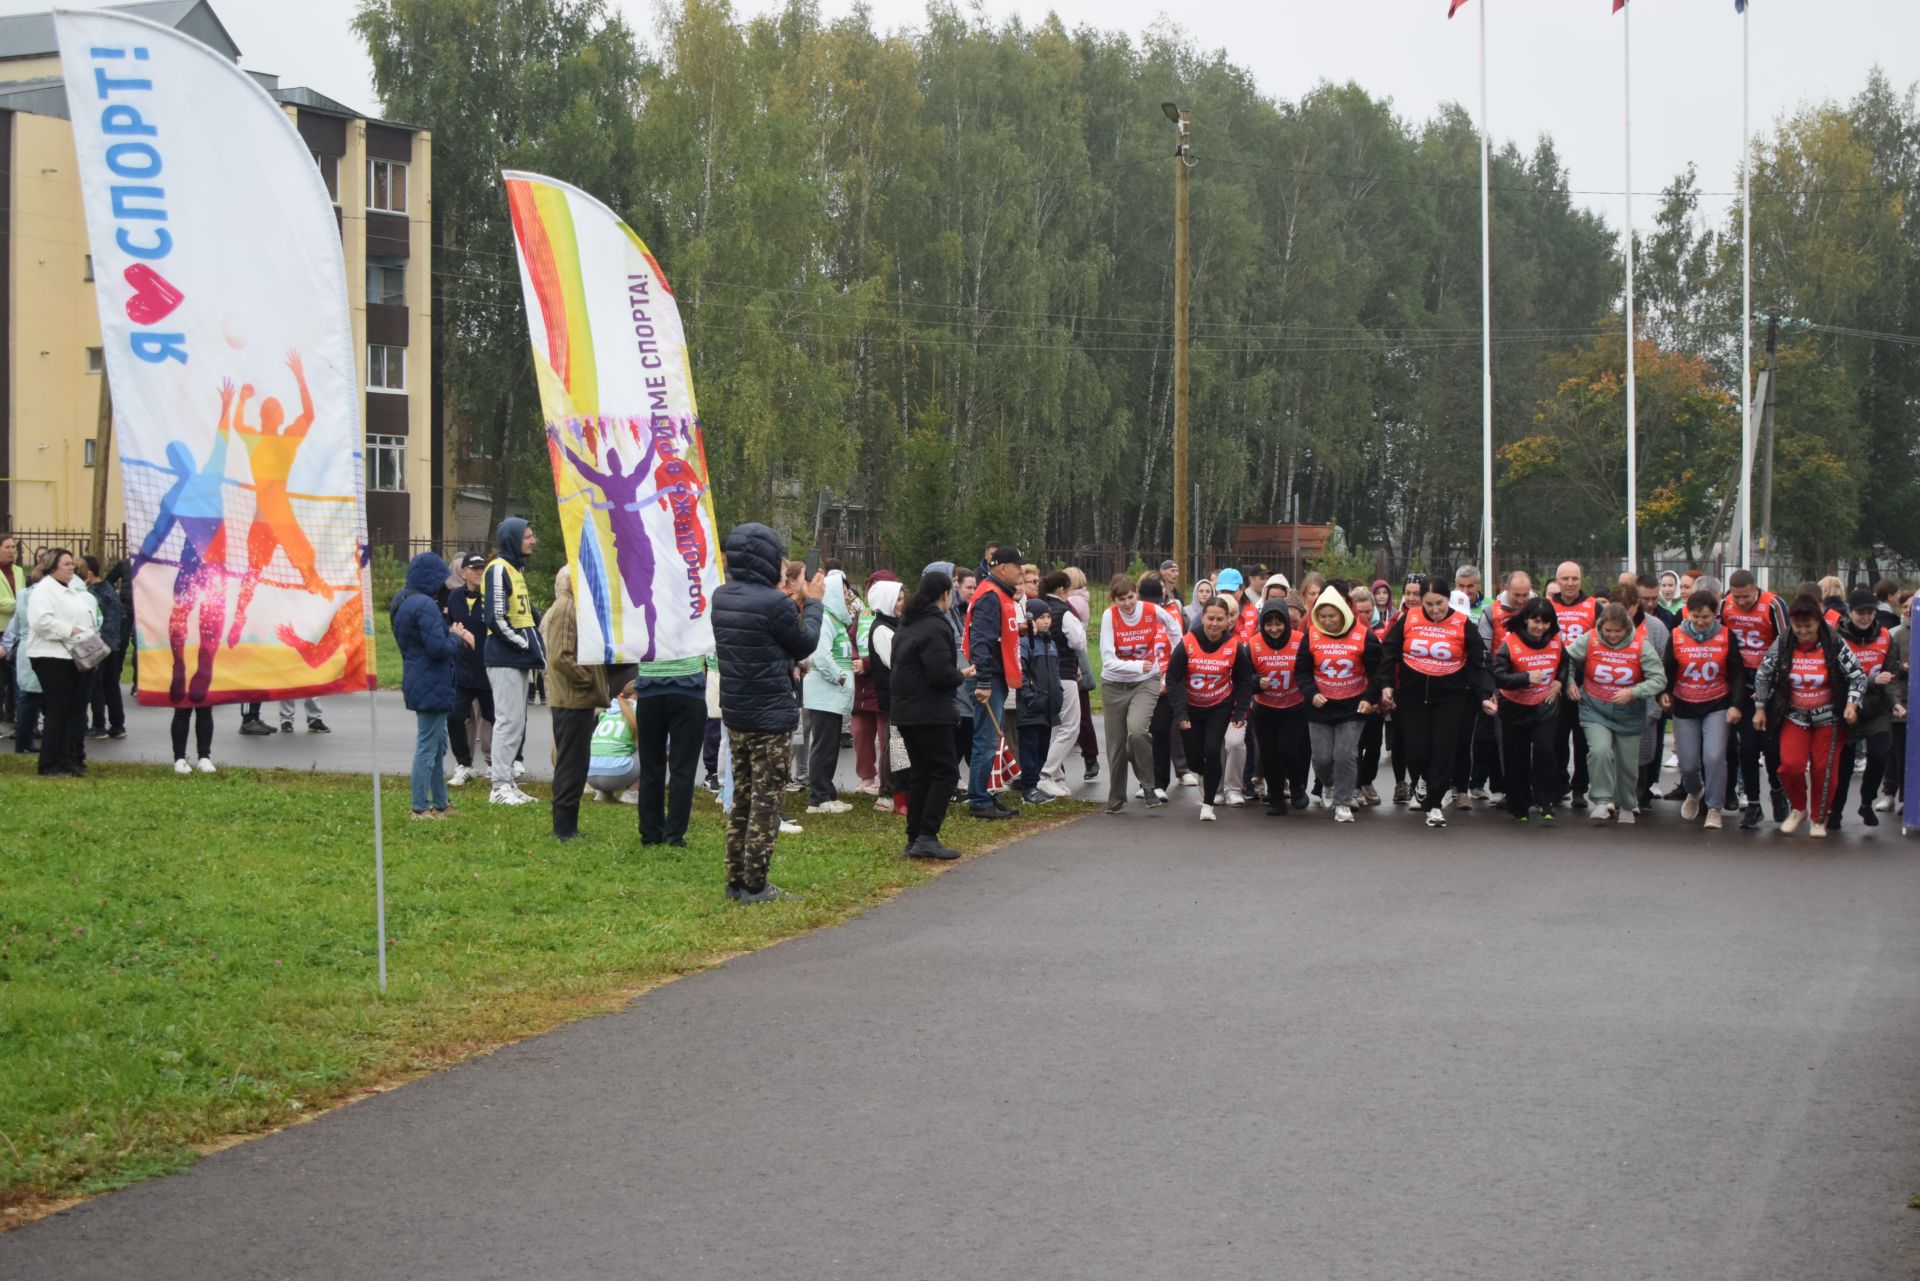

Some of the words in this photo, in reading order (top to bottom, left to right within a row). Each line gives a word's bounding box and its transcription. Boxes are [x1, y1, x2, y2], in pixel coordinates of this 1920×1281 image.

[90, 47, 173, 260] СПОРТ!
[628, 274, 662, 369] СПОРТА!
[130, 332, 189, 365] Я
[645, 376, 680, 454] РИТМЕ
[667, 461, 683, 475] В
[1410, 638, 1452, 659] 56
[1320, 658, 1354, 678] 42
[1593, 664, 1633, 685] 52
[1683, 662, 1719, 681] 40
[1190, 673, 1223, 689] 67
[1789, 673, 1825, 689] 27
[592, 719, 626, 739] 01
